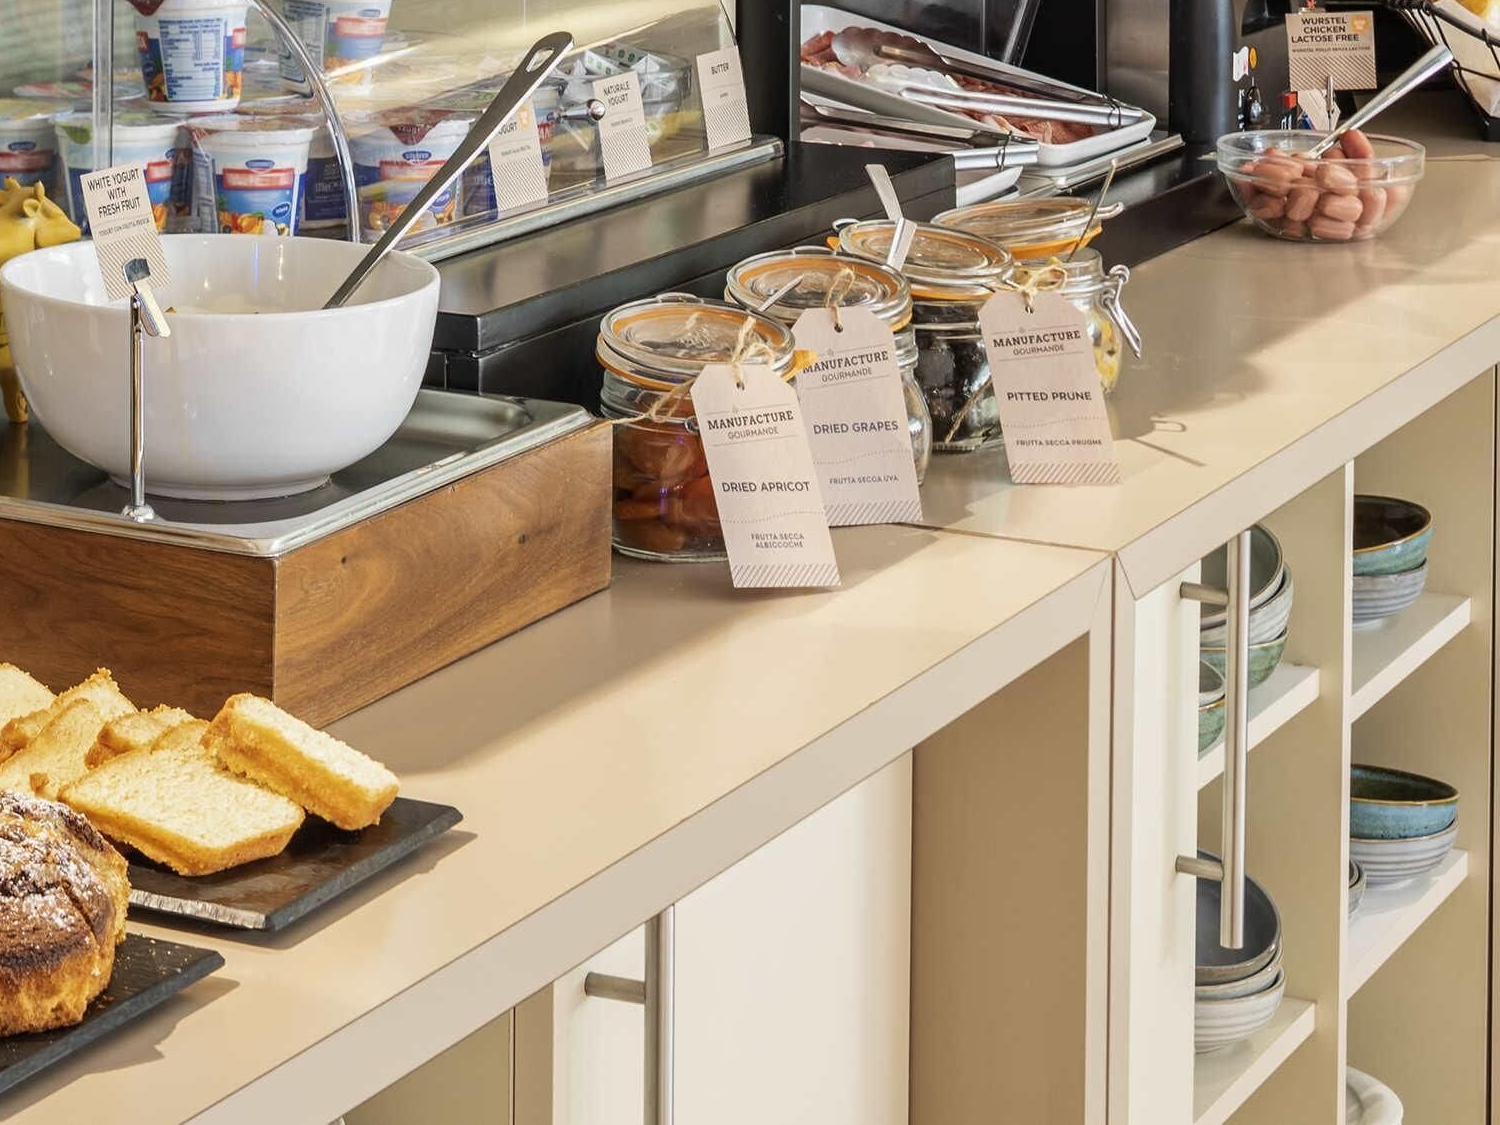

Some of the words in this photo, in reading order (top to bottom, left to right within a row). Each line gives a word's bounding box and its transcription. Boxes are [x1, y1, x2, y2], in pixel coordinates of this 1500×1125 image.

[1301, 17, 1348, 25] WURSTEL
[1303, 26, 1346, 34] CHICKEN
[1291, 35, 1333, 43] LACTOSE
[1335, 34, 1359, 42] FREE
[87, 175, 112, 192] WHITE
[111, 168, 140, 184] YOGURT
[107, 186, 127, 201] WITH
[98, 203, 121, 218] FRESH
[120, 196, 141, 211] FRUIT
[993, 330, 1082, 348] MANUFACTURE
[1013, 344, 1065, 356] GOURMANDE
[803, 350, 889, 374] MANUFACTURE
[821, 367, 872, 383] GOURMANDE
[1007, 391, 1049, 401] PITTED
[1052, 391, 1092, 401] PRUNE
[707, 410, 794, 430] MANUFACTURE
[813, 423, 849, 434] DRIED
[852, 420, 899, 433] GRAPES
[727, 426, 779, 440] GOURMANDE
[883, 474, 899, 482] UVA
[722, 482, 757, 492] DRIED
[760, 481, 811, 492] APRICOT
